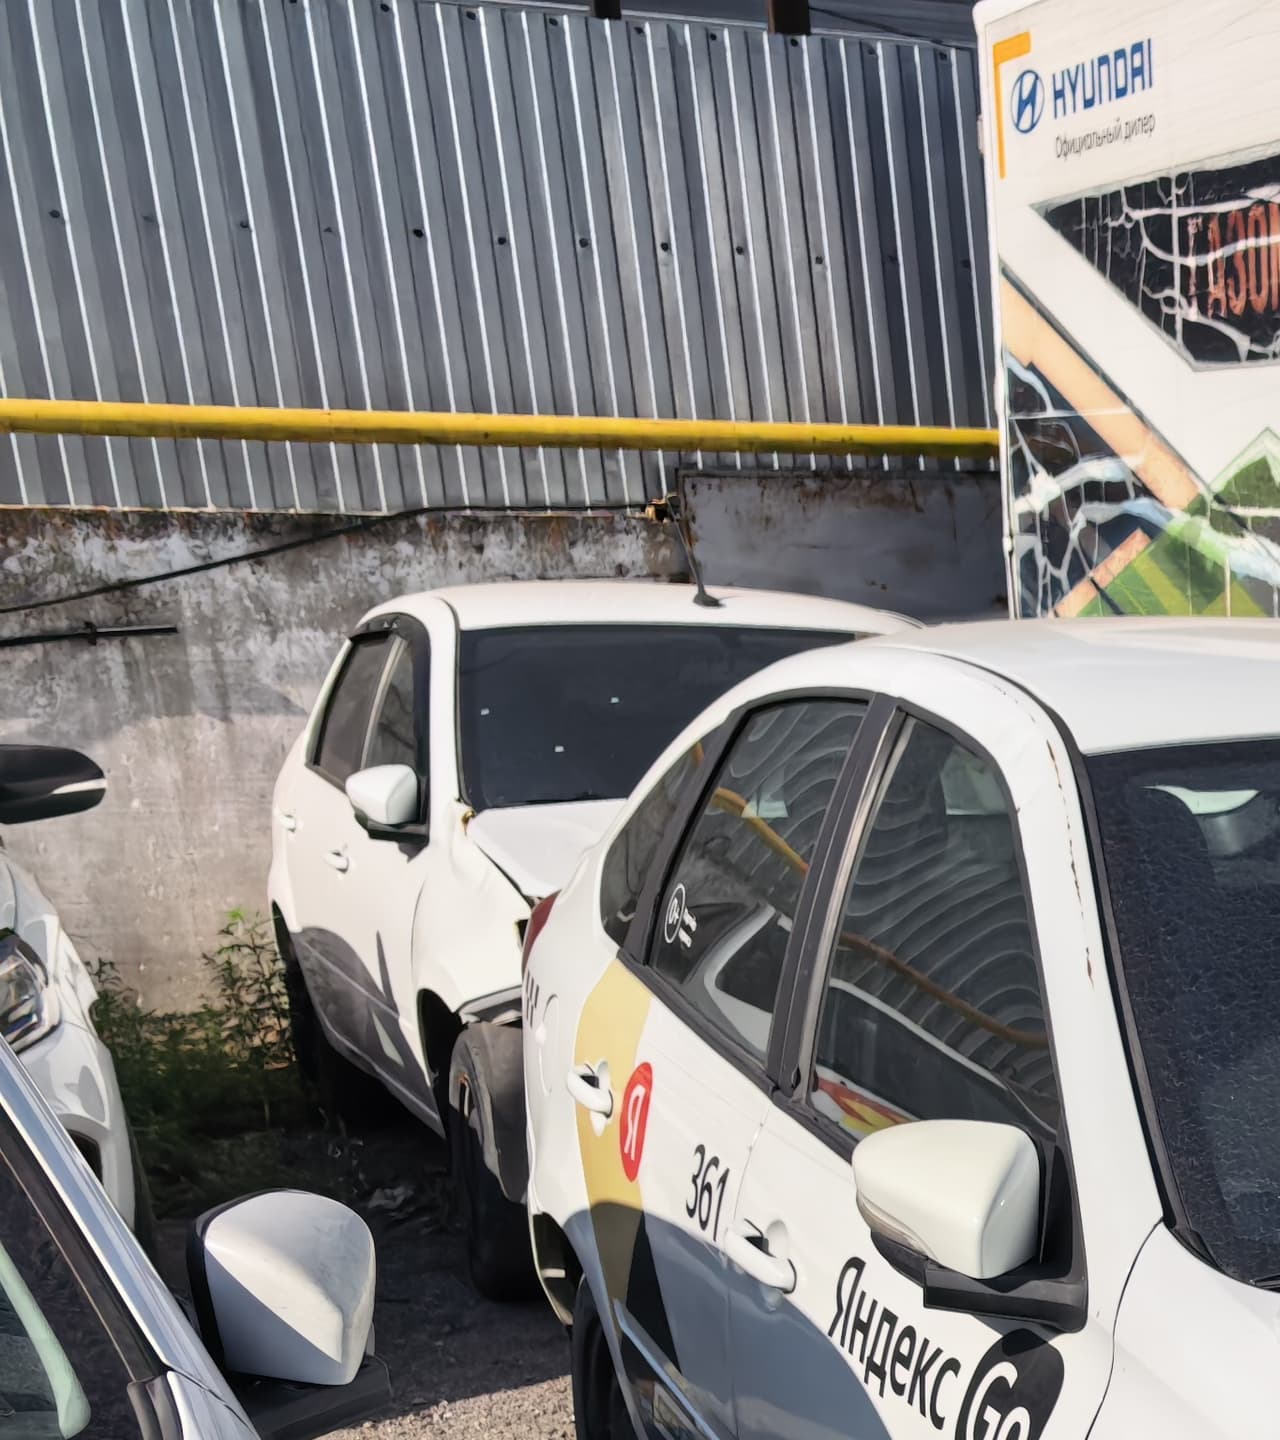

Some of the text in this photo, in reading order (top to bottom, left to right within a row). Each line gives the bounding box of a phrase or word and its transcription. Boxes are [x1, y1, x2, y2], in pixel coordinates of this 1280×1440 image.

[1052, 38, 1152, 119] HYUNDAI
[1055, 113, 1156, 162] Официальный дилер
[624, 1084, 647, 1161] Я
[685, 1143, 730, 1242] 361
[828, 1256, 962, 1431] Яндекс
